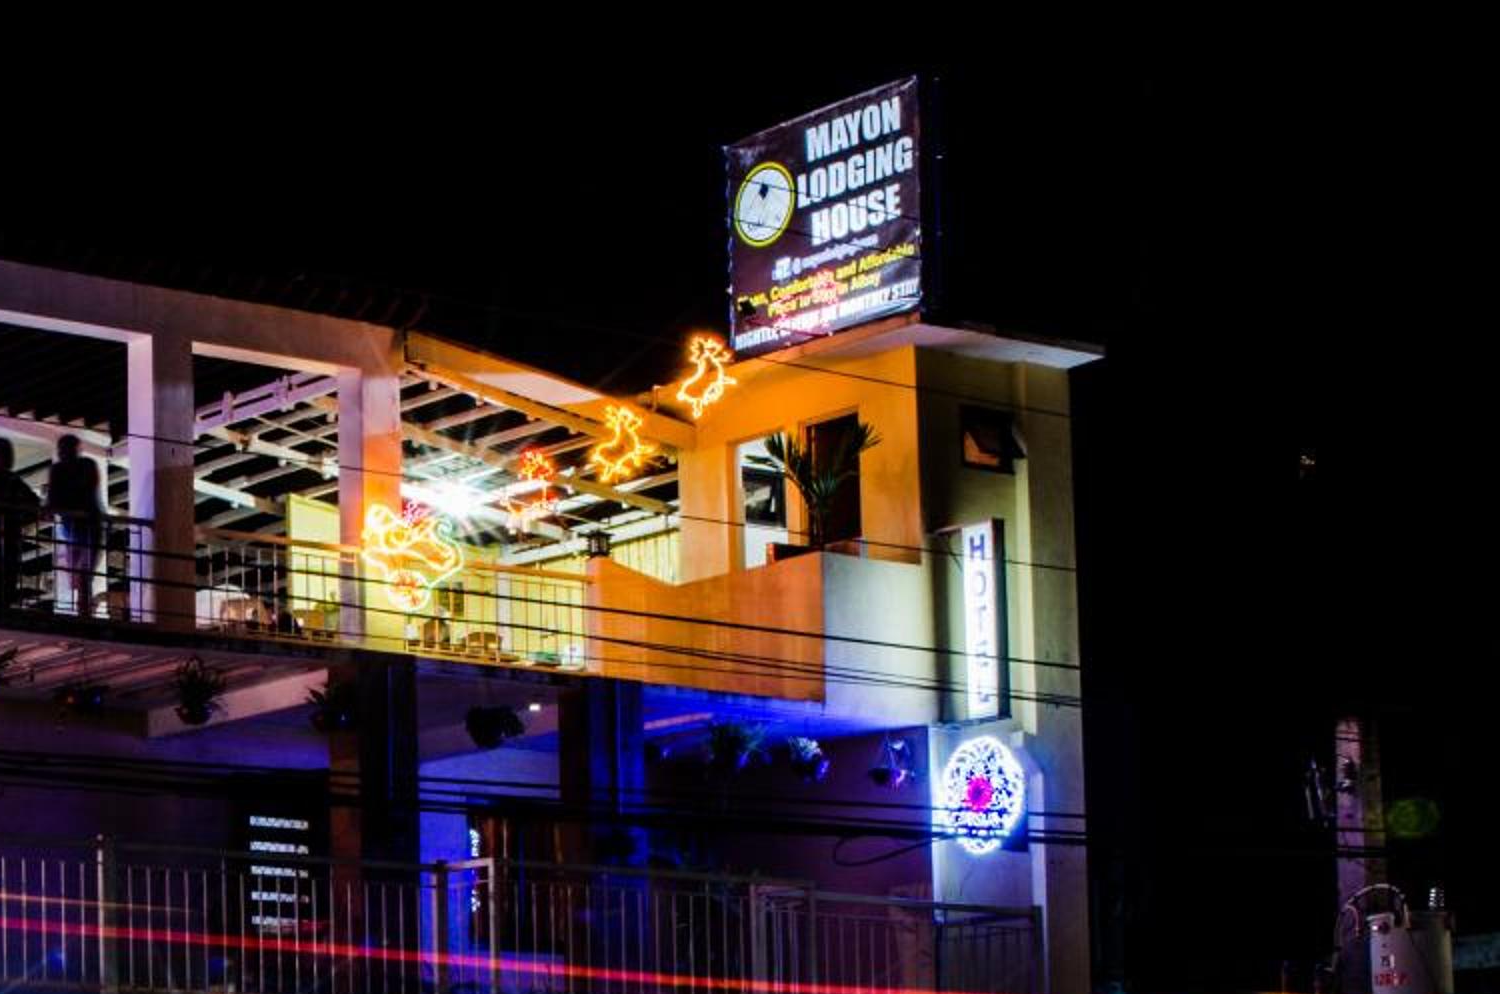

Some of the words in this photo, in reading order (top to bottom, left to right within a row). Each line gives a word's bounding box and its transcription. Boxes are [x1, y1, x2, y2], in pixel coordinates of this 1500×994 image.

[805, 96, 902, 162] MAYON
[796, 137, 914, 209] LODGING
[810, 183, 902, 247] HOUSE
